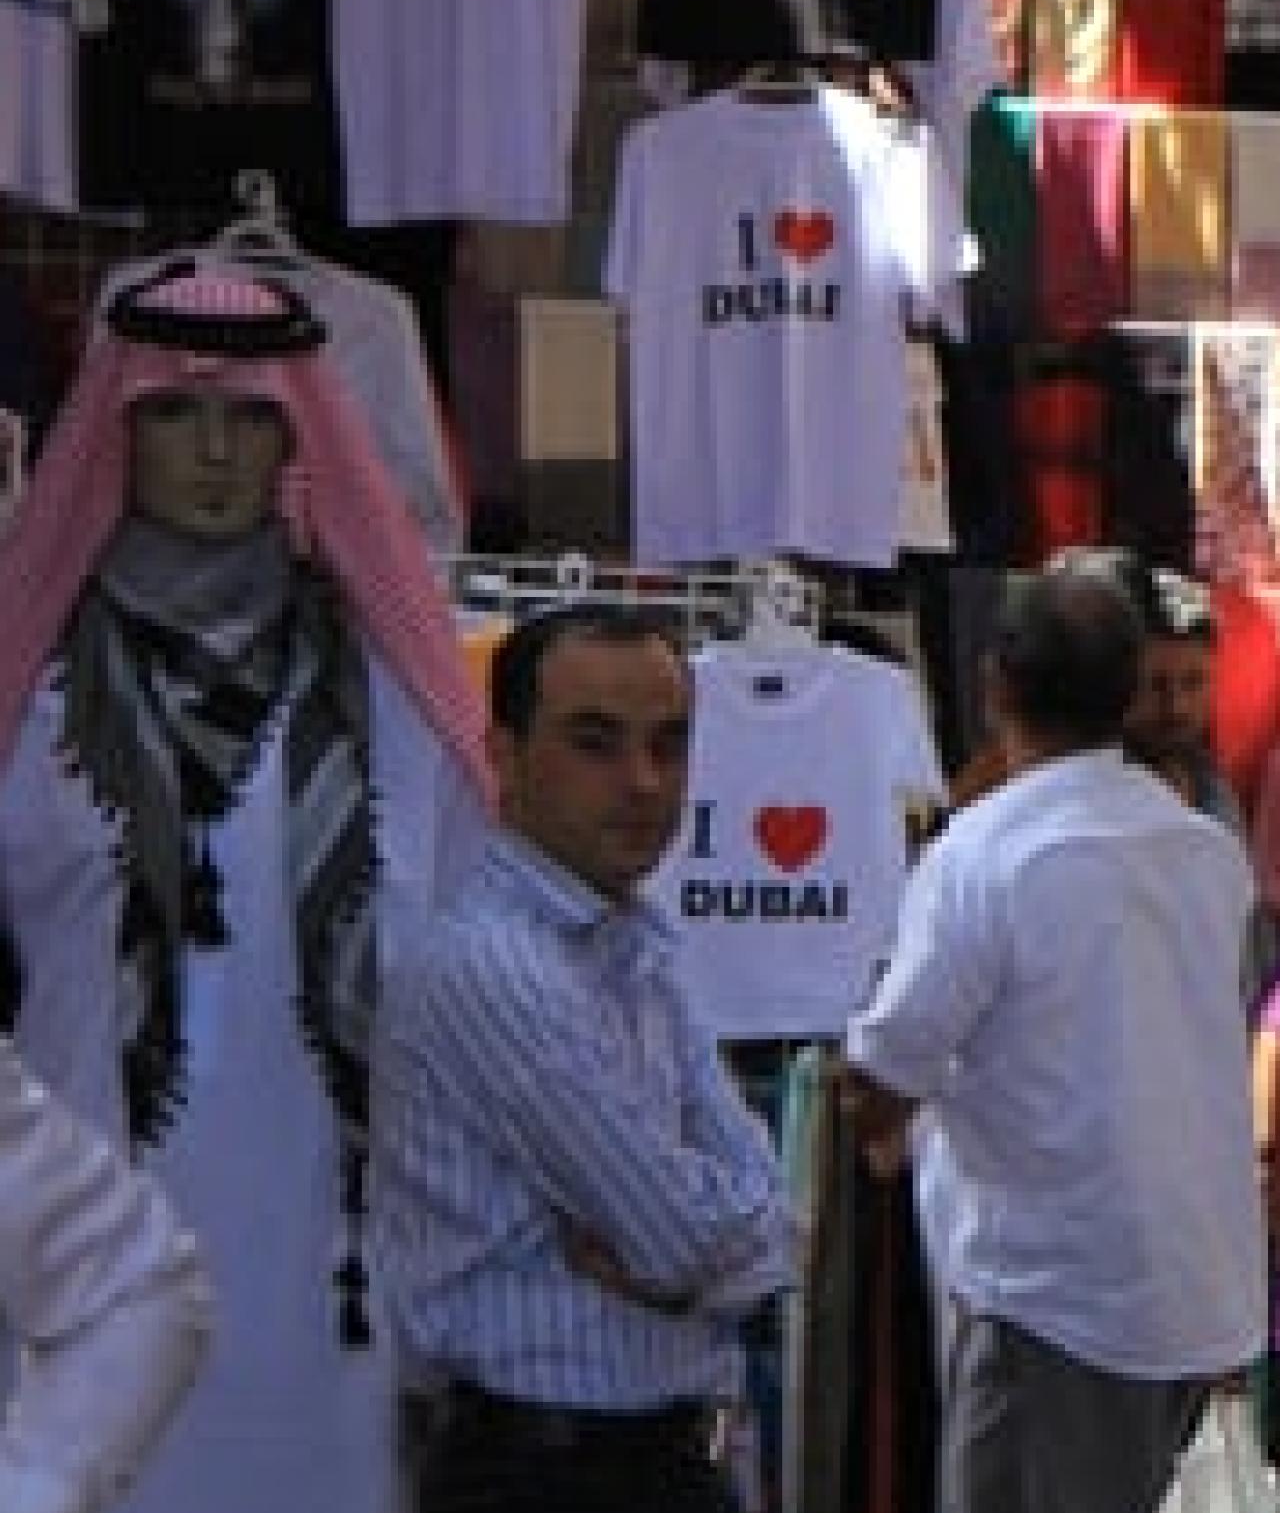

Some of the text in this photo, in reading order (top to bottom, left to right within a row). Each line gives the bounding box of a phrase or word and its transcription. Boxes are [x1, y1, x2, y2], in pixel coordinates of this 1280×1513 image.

[737, 213, 757, 271] I
[688, 800, 717, 858] I
[681, 880, 848, 923] DUBAI
